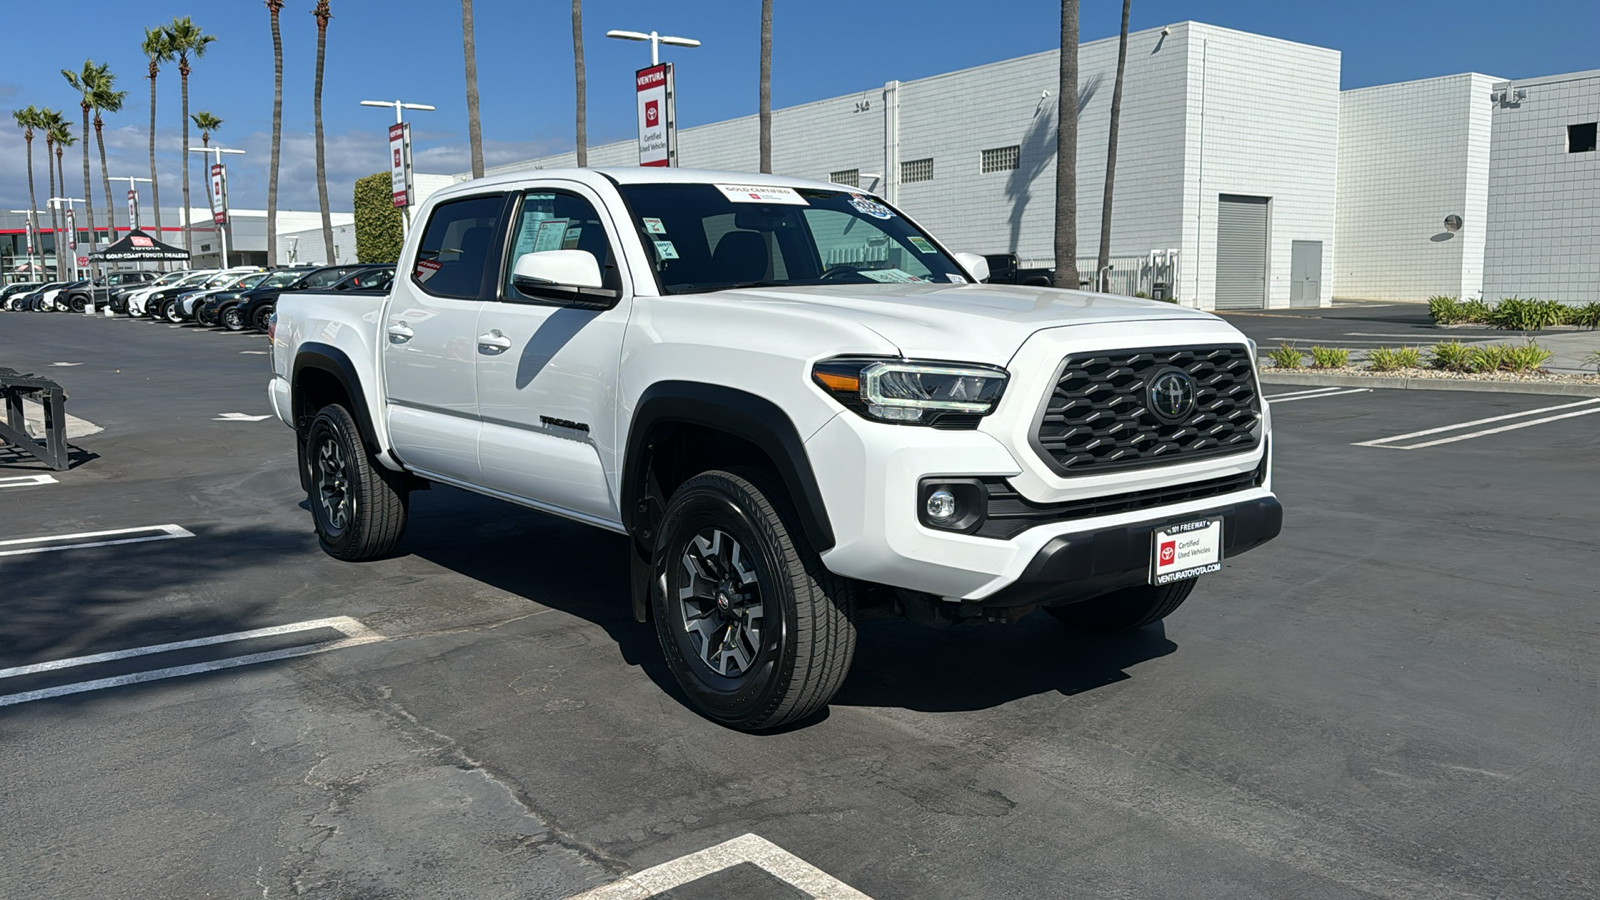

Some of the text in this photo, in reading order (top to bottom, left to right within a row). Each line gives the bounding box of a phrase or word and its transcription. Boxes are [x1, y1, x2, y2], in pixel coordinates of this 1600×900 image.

[637, 71, 665, 86] VENTURA
[644, 132, 662, 143] Certified
[640, 140, 667, 153] Used Vehicles
[750, 187, 790, 195] CERTIFIED
[1180, 520, 1207, 532] FREEWAY
[1178, 538, 1200, 550] Certified
[1177, 546, 1211, 559] Used Vehicles
[1157, 563, 1221, 584] VENTURATOYOTA.COM
